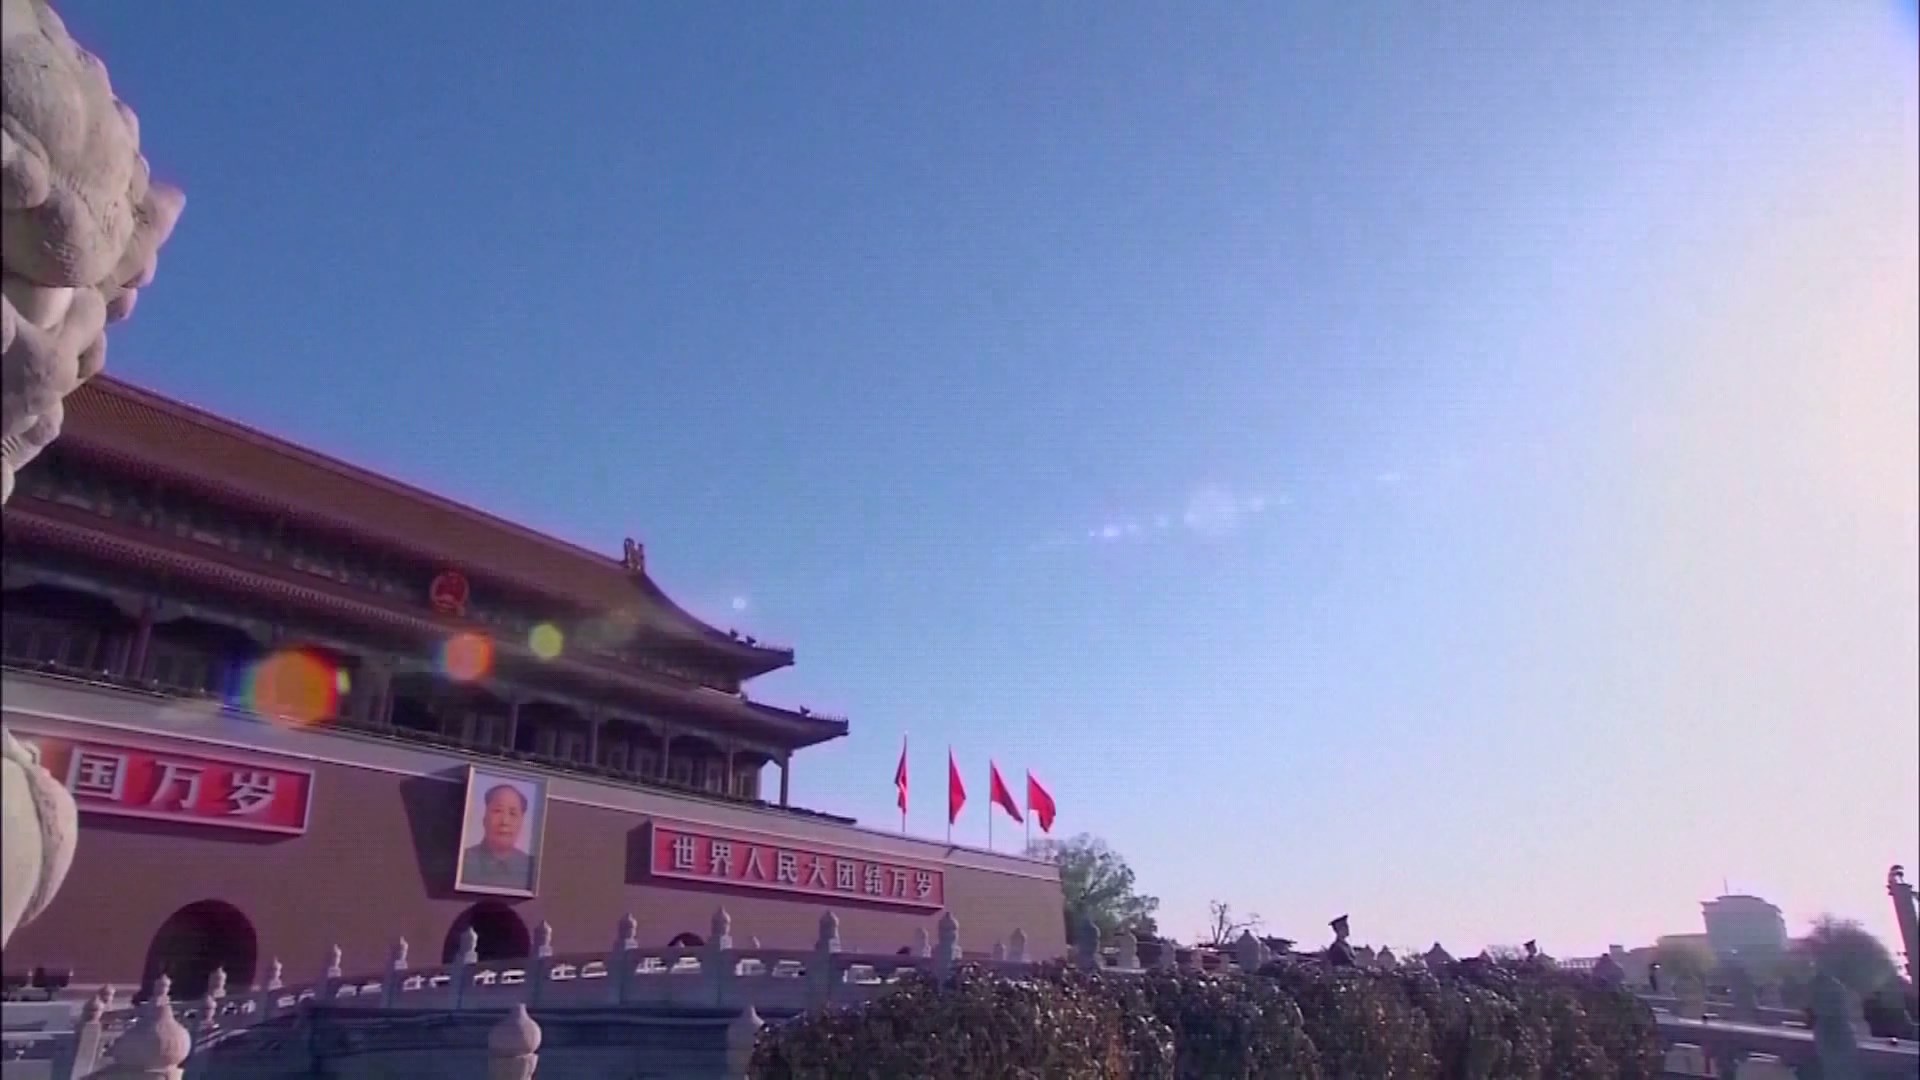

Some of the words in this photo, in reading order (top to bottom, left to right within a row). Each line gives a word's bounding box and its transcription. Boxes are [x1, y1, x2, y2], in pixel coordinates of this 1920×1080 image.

[68, 748, 276, 815] 国万岁
[674, 837, 933, 898] 世界人民大团结万岁
